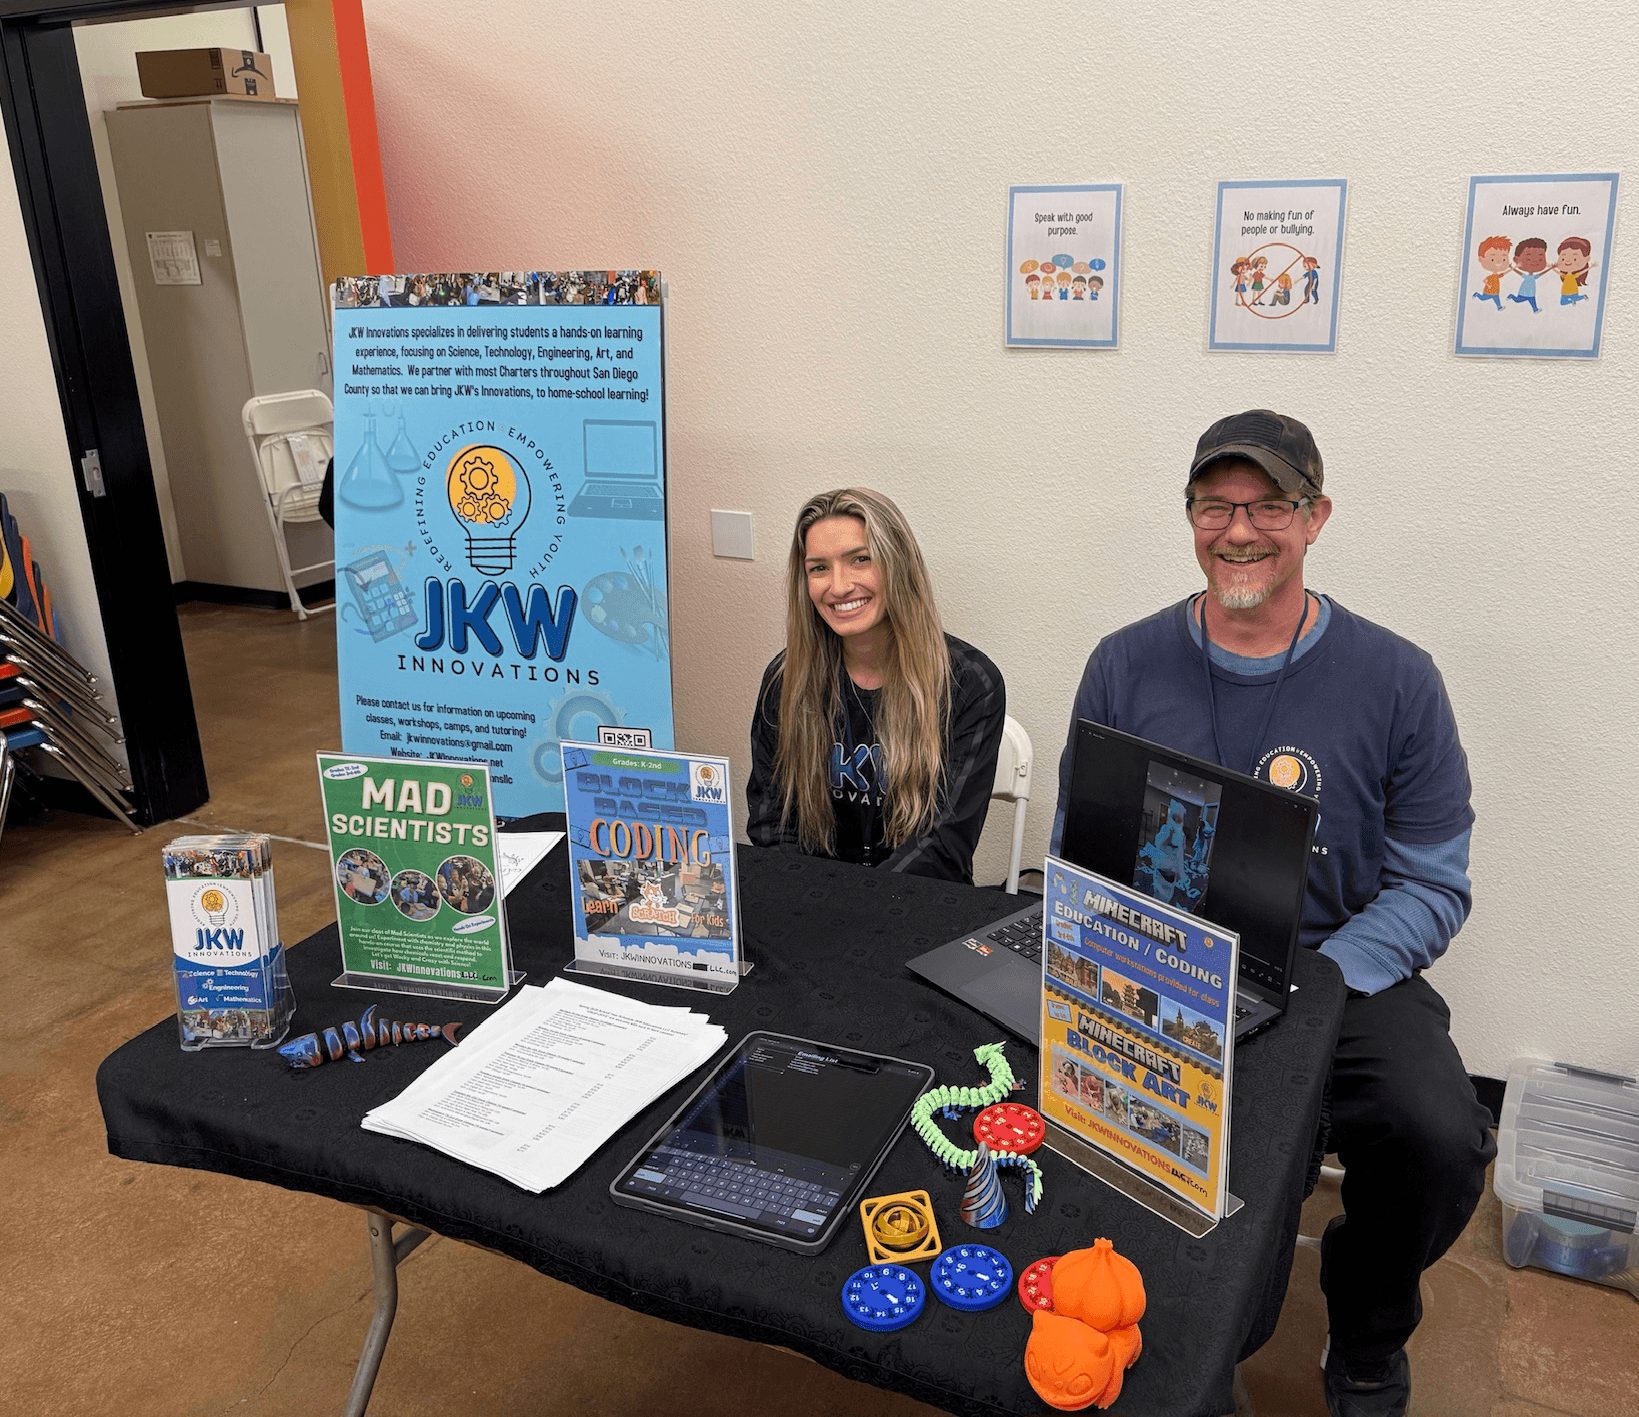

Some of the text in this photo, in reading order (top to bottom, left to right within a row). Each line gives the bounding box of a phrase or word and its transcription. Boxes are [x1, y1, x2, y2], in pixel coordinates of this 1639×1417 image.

[1034, 212, 1093, 224] Speak with good
[1243, 210, 1314, 222] No making fun of
[1502, 204, 1581, 217] Always have fun.
[1047, 227, 1078, 237] purpose.
[1241, 224, 1314, 236] people or bullying.
[349, 326, 643, 341] JKW Innovations specializes in delivering students a hands-on learning
[356, 346, 633, 361] experience, focusing on Science, Technology, Engineering, Art, and
[352, 365, 638, 382] Mathematics. We partner with most Charters throughout San Diego
[344, 384, 648, 402] County so that we can bring JKW's Innovations, to home-school learning!
[415, 421, 566, 579] REDEFINING EDUCATION EMPOWERING YOUTH
[414, 576, 578, 663] JKW
[397, 654, 600, 685] INNOVATIONS
[356, 694, 536, 723] Please contact us for information on upcoming
[366, 713, 527, 738] classes, workshops, camps, and tutoring!
[380, 730, 402, 741] Email:
[612, 758, 662, 769] Grades: K-2nd
[1259, 746, 1296, 765] EDUCATION
[1300, 750, 1322, 792] EMPOWERING
[362, 777, 452, 815] MAD
[577, 771, 692, 803] BLOCK
[696, 785, 722, 800] JKW
[332, 814, 488, 847] SCIENTISTS
[590, 817, 712, 867] CODING
[582, 897, 618, 914] Learn
[1083, 890, 1188, 953] MINECRAFT
[194, 928, 244, 951] JKW
[1055, 900, 1139, 951] EDUCATION
[1156, 948, 1222, 989] CODING
[223, 995, 262, 1003] Mathematics
[1078, 1013, 1180, 1084] MINECRAFT
[1067, 1028, 1190, 1109] BLOCK ART
[1065, 1104, 1086, 1124] Visit:
